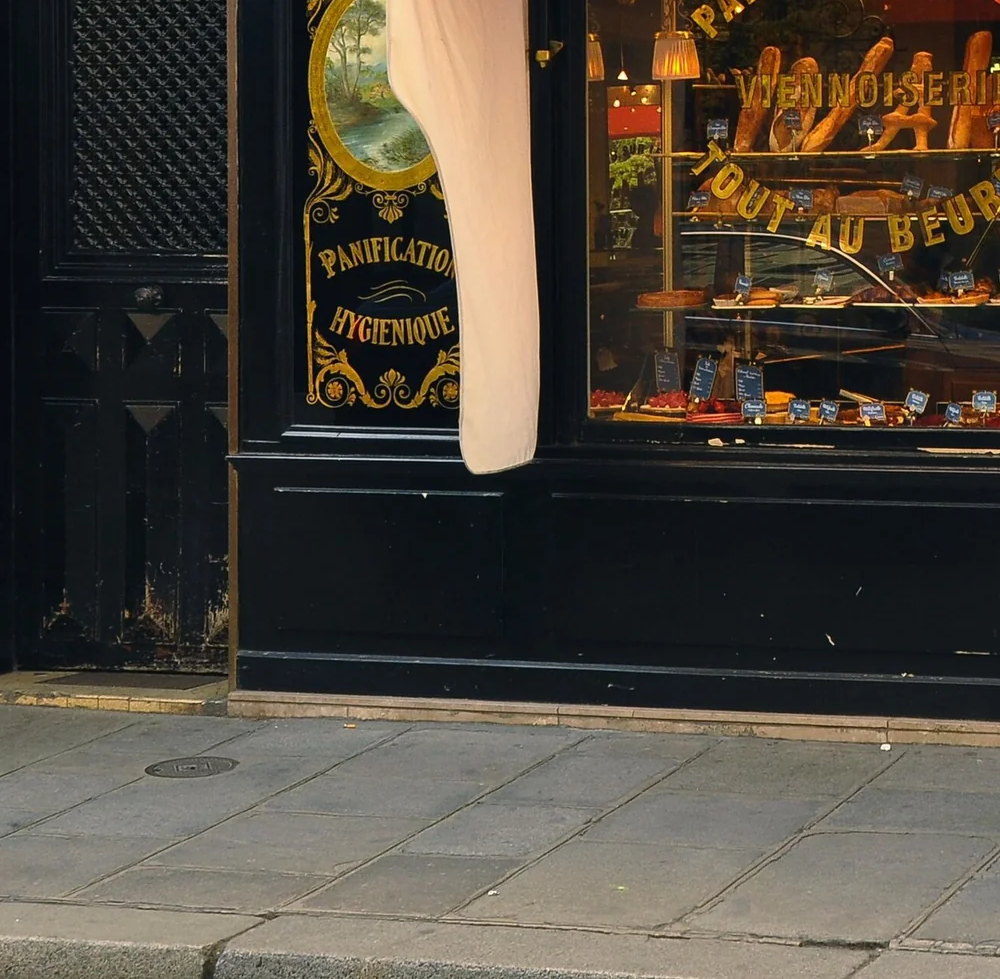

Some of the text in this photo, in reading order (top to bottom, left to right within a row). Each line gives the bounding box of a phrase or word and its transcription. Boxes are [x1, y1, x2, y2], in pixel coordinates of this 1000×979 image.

[690, 140, 795, 234] TOUT
[805, 213, 865, 254] AU
[329, 305, 456, 347] HYGIENIQUE
